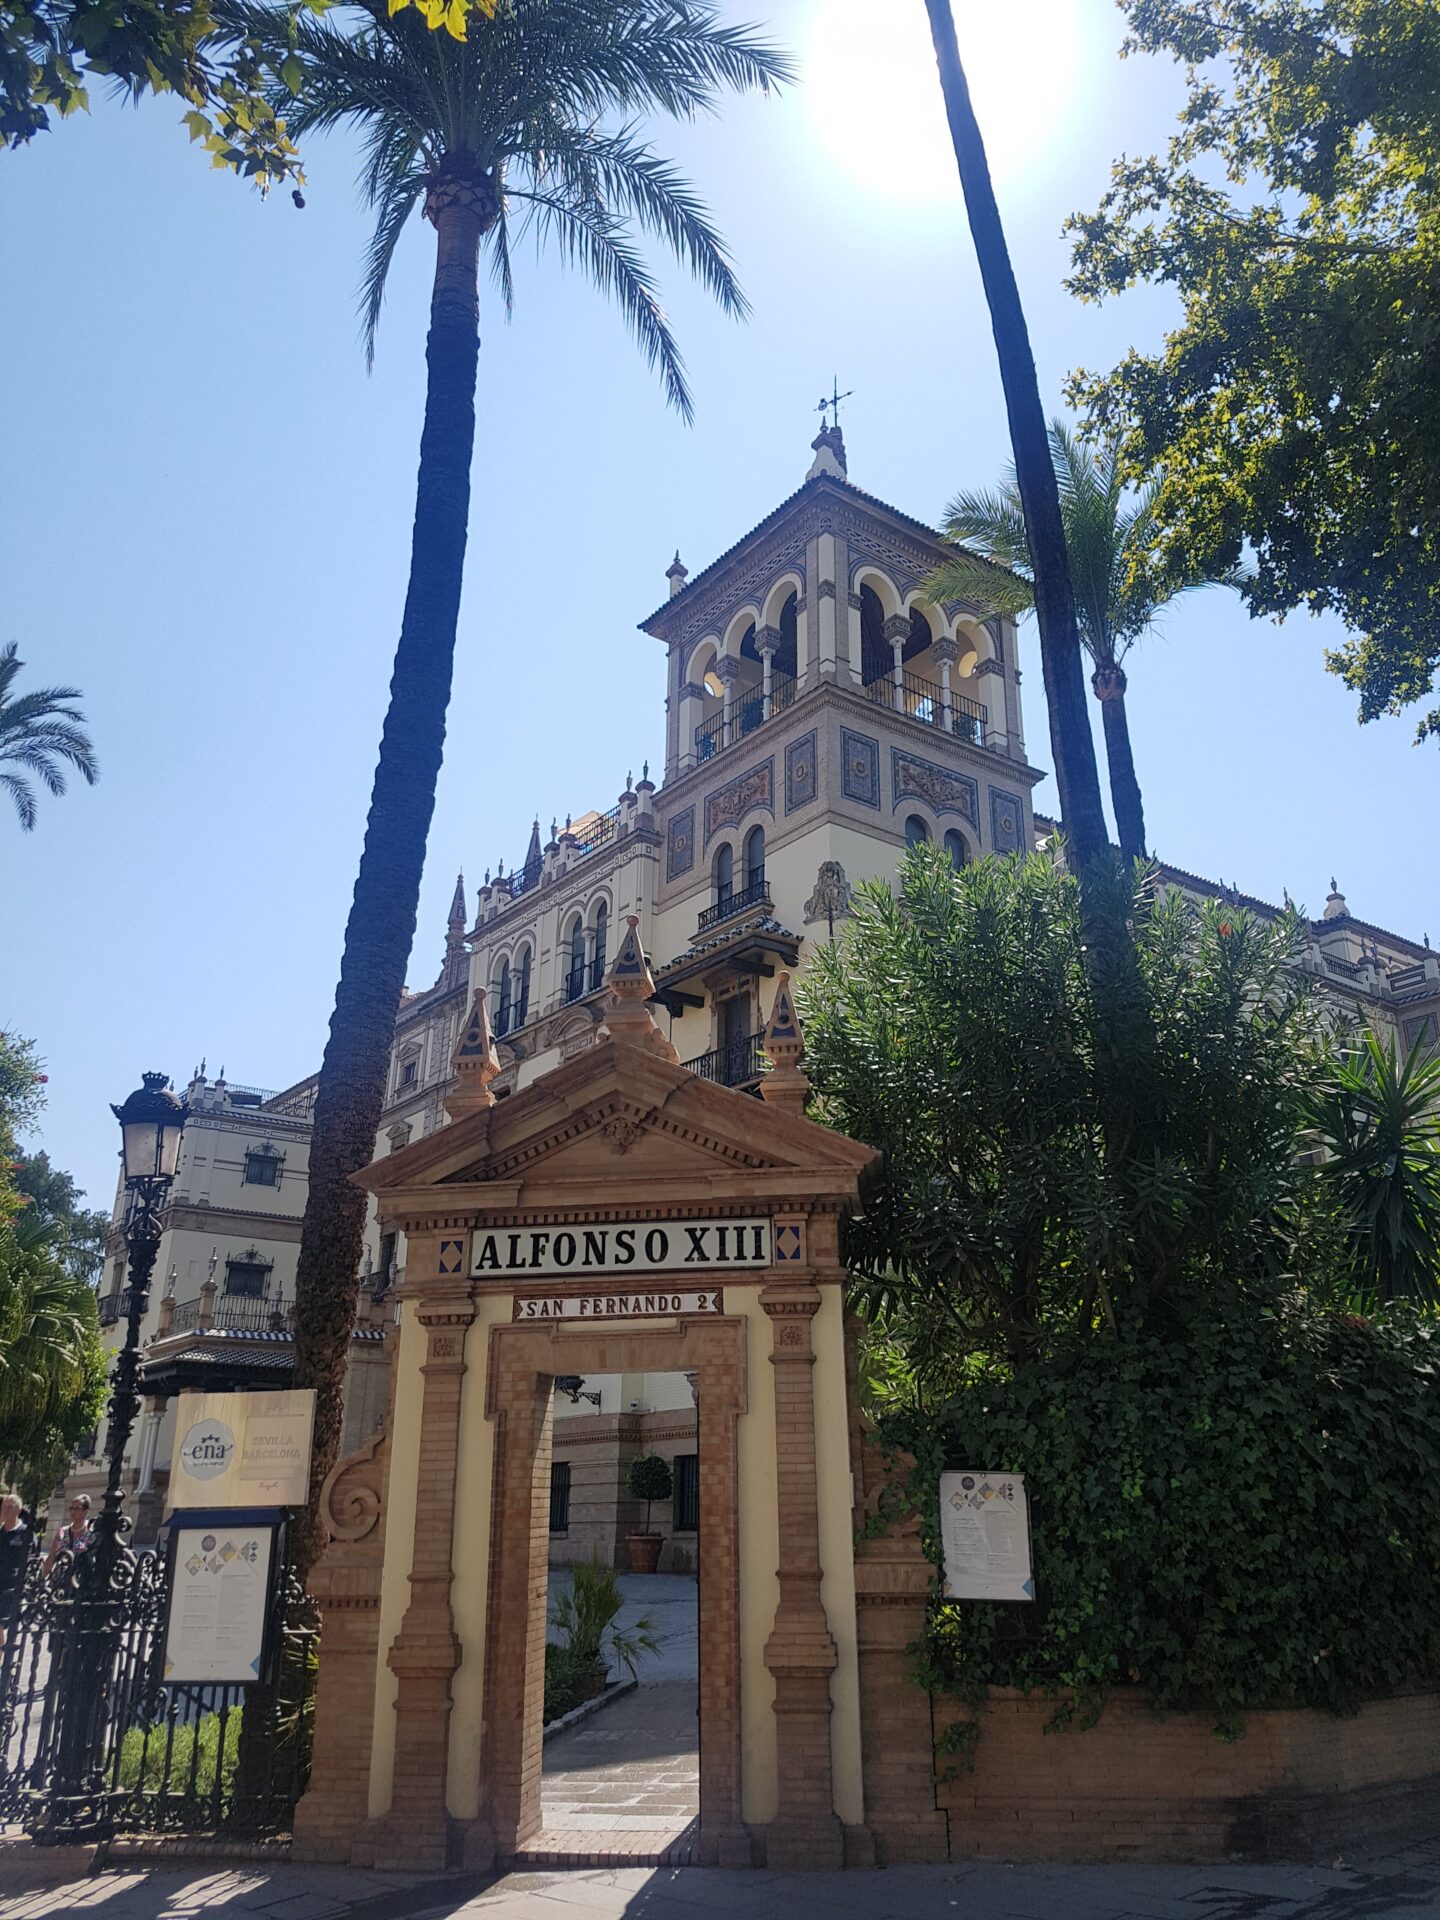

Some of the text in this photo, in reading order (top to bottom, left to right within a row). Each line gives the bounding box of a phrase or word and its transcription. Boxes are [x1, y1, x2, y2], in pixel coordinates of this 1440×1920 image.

[475, 1225, 766, 1270] ALFONSO XIII
[526, 1293, 709, 1316] SAN FERNANDO 2
[253, 1435, 294, 1446] SEVILLA
[184, 1443, 233, 1460] ena
[243, 1449, 300, 1460] BARCELONA
